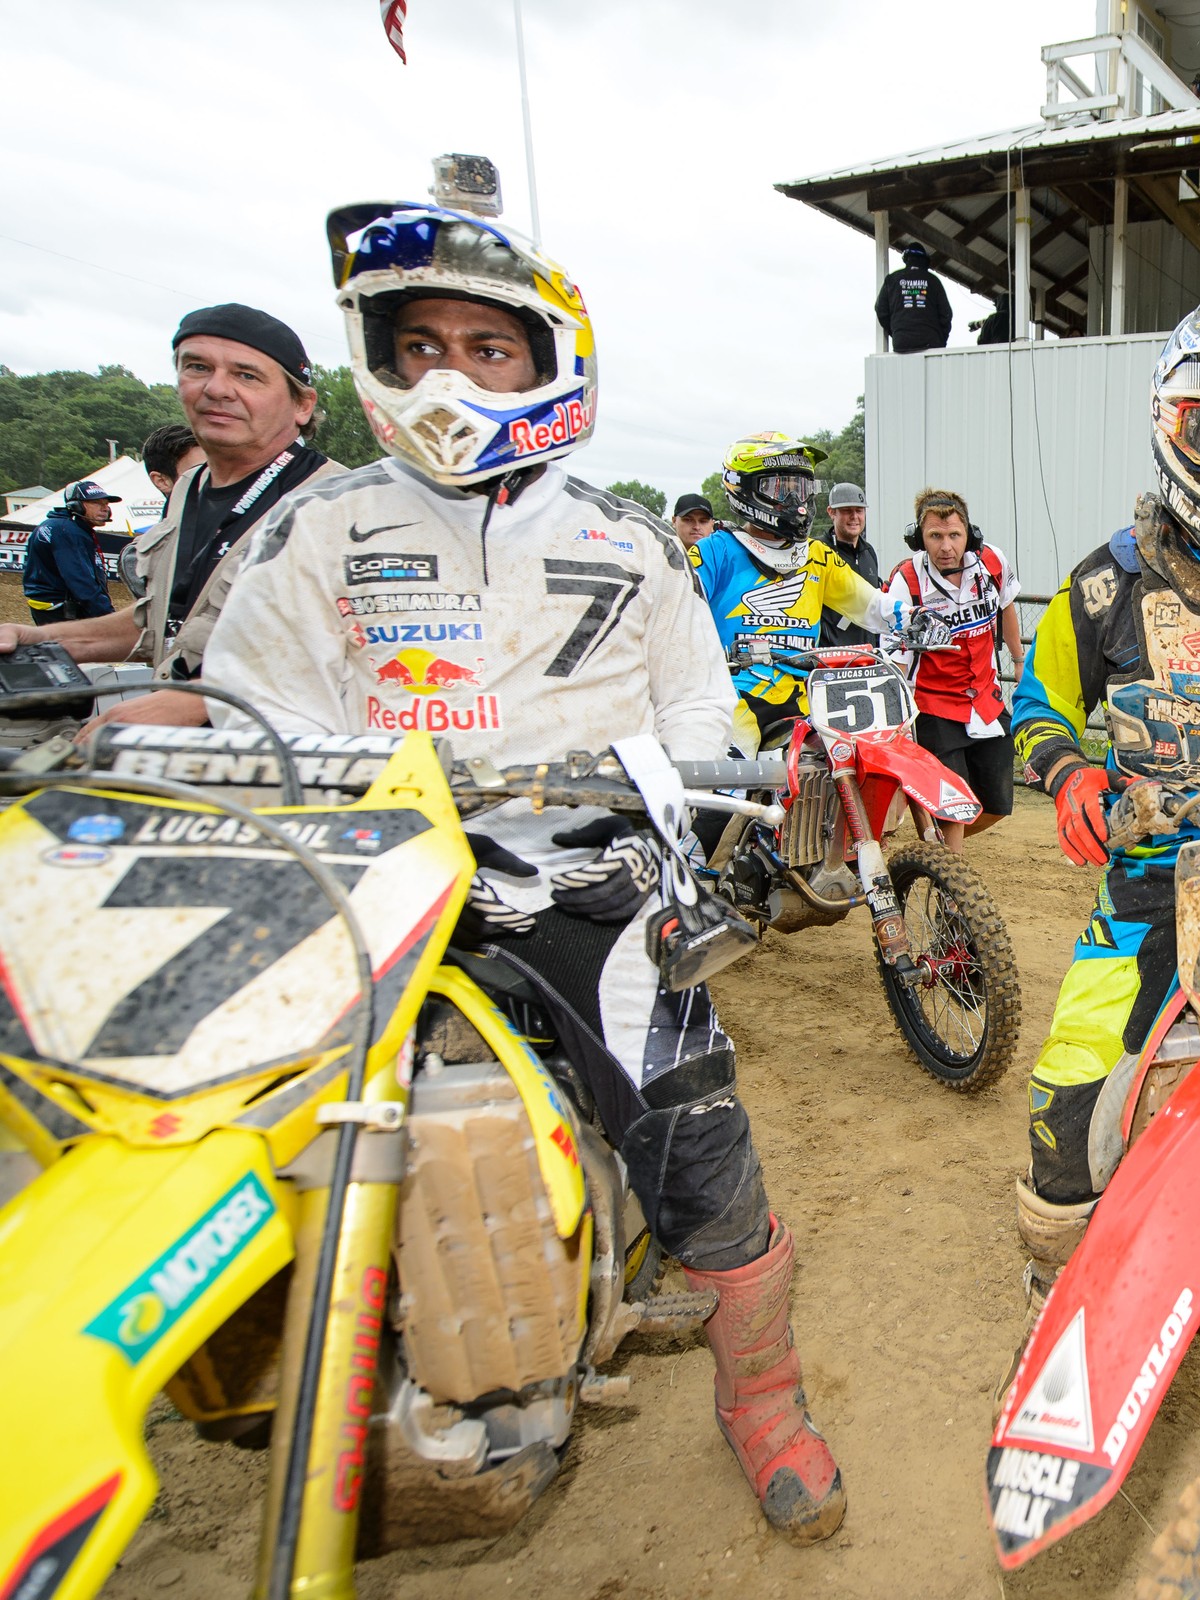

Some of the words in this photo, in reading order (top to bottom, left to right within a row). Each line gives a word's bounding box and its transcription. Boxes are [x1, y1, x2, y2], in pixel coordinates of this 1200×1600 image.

[509, 406, 566, 454] Red
[754, 509, 779, 527] MILK
[350, 558, 431, 572] GoPro
[351, 594, 480, 615] YOSHIMURA
[544, 558, 645, 677] 7
[366, 623, 482, 644] SUZUKI
[742, 615, 811, 629] HONDA
[786, 637, 814, 651] MILK
[837, 669, 862, 679] LUCAS
[864, 669, 877, 678] OIL
[367, 696, 420, 730] Red
[427, 695, 499, 731] Bull
[826, 678, 904, 734] 51
[903, 785, 938, 811] DUNLOP
[944, 803, 976, 815] MUSCLE
[838, 783, 865, 841] SHOWA
[954, 811, 976, 820] MILK
[134, 816, 260, 845] LUCAS
[735, 881, 754, 893] HONDA
[873, 897, 895, 912] MILK
[81, 857, 370, 1060] 7
[150, 1181, 271, 1310] MOTOREX
[1101, 1287, 1194, 1466] DUNLOP
[994, 1447, 1080, 1503] MUSCLE
[993, 1488, 1052, 1539] MILK
